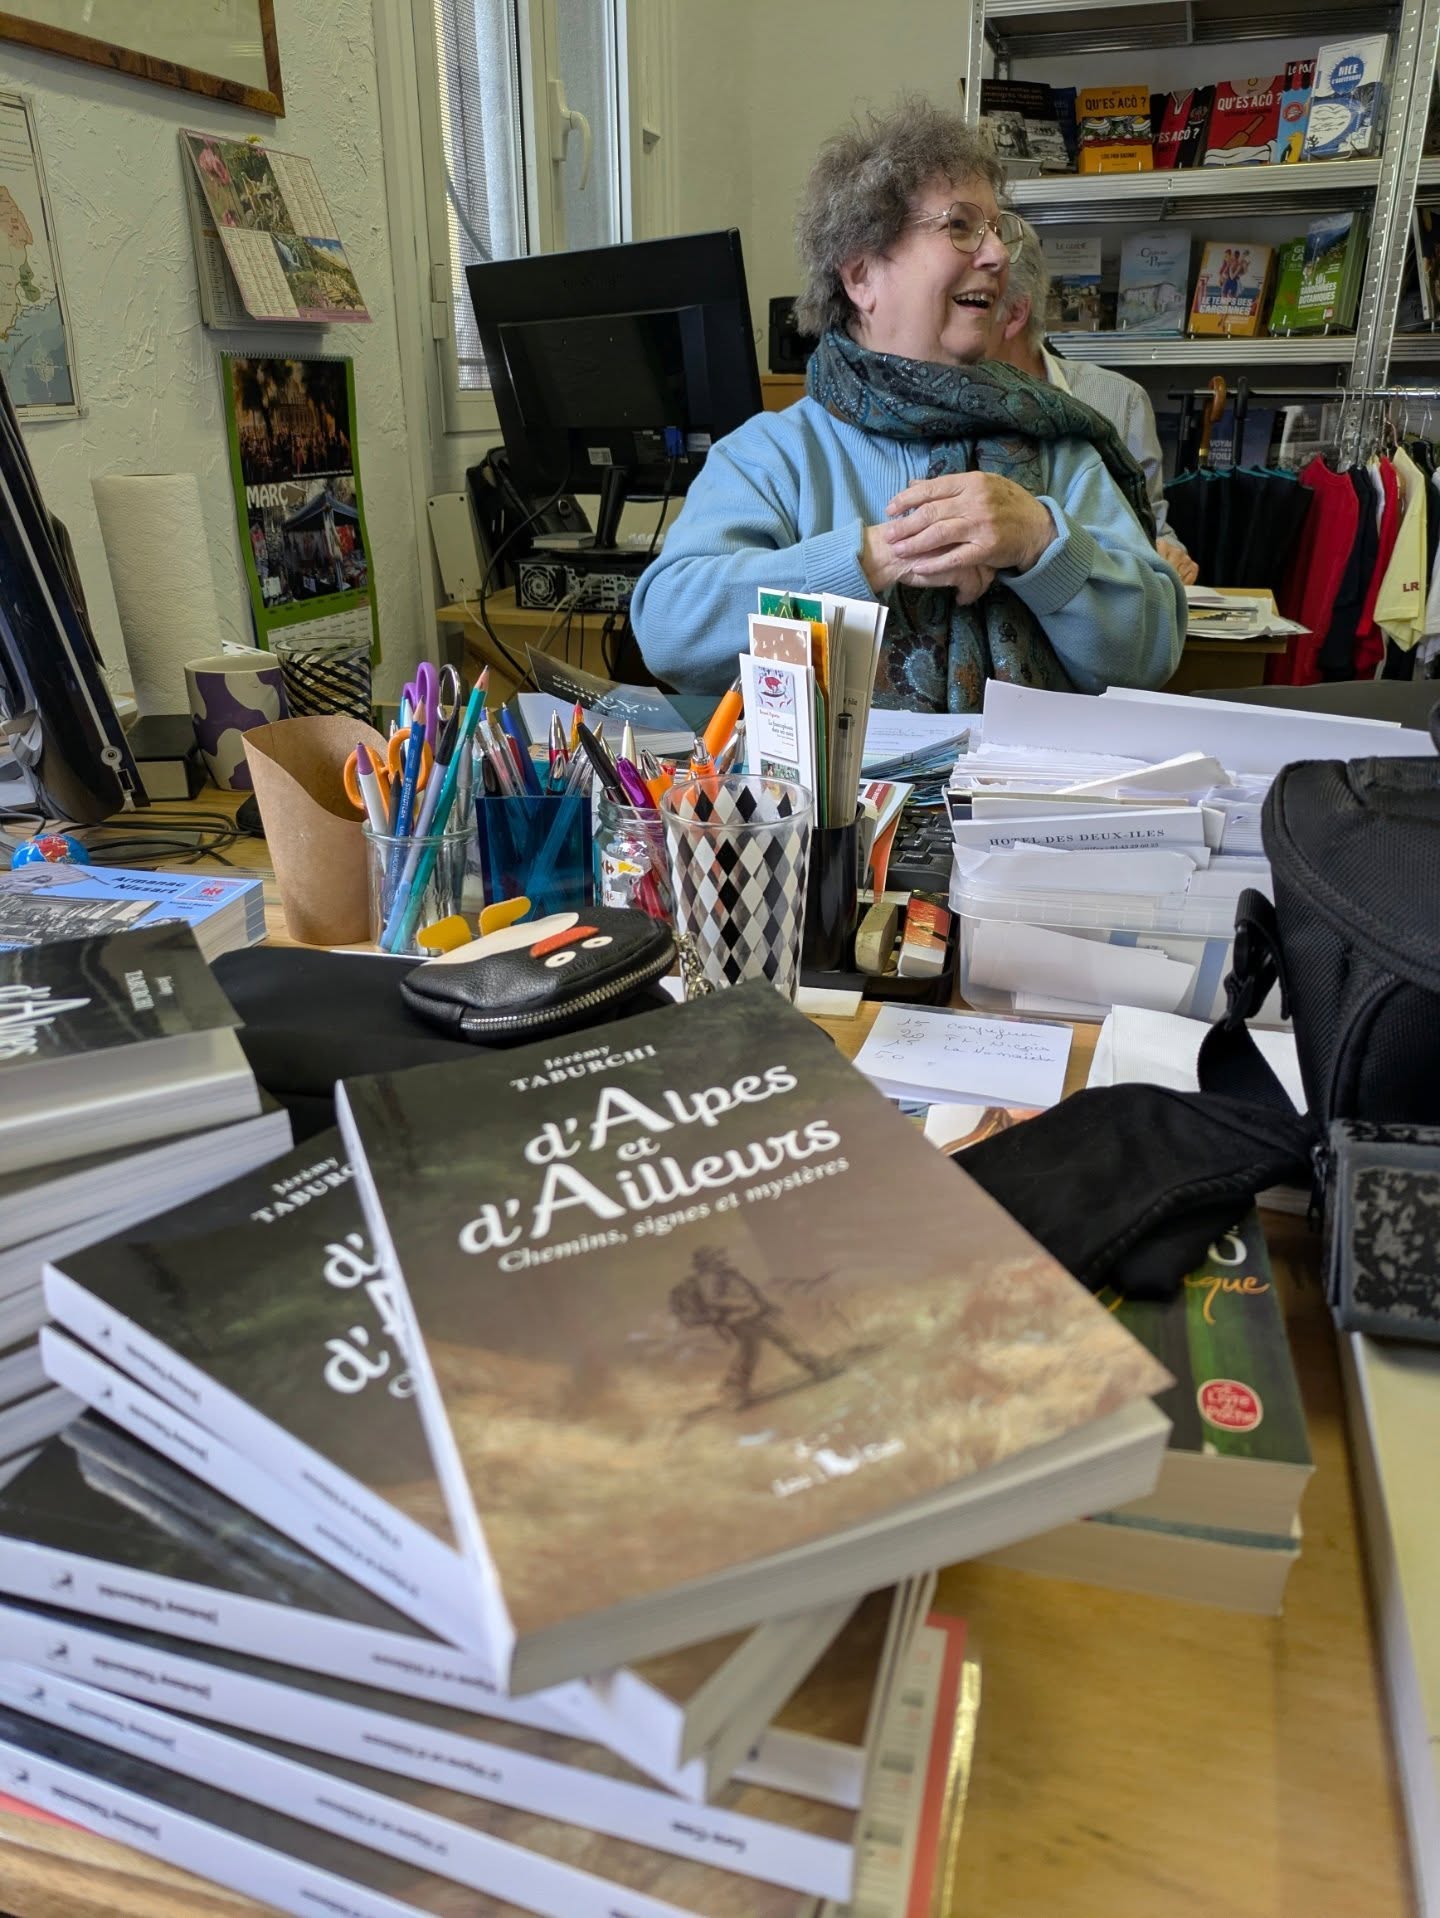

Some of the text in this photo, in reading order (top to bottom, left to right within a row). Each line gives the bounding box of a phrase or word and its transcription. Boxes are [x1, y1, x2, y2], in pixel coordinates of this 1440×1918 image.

[1085, 96, 1115, 111] QU'ES
[1217, 95, 1249, 111] QU'ES
[1402, 581, 1420, 592] LR
[1045, 833, 1074, 844] DES
[1079, 828, 1165, 842] DEUX-ILES
[112, 876, 187, 887] Armanac
[113, 883, 179, 894] Nissart
[509, 1044, 657, 1093] TABURCHI
[543, 1044, 612, 1071] Jérémy
[524, 1065, 799, 1165] d'Alpes
[616, 1135, 661, 1162] et
[251, 1162, 356, 1224] TABURC
[458, 1119, 842, 1255] d'Ailleurs
[498, 1156, 850, 1273] Chemins, signes et mystères
